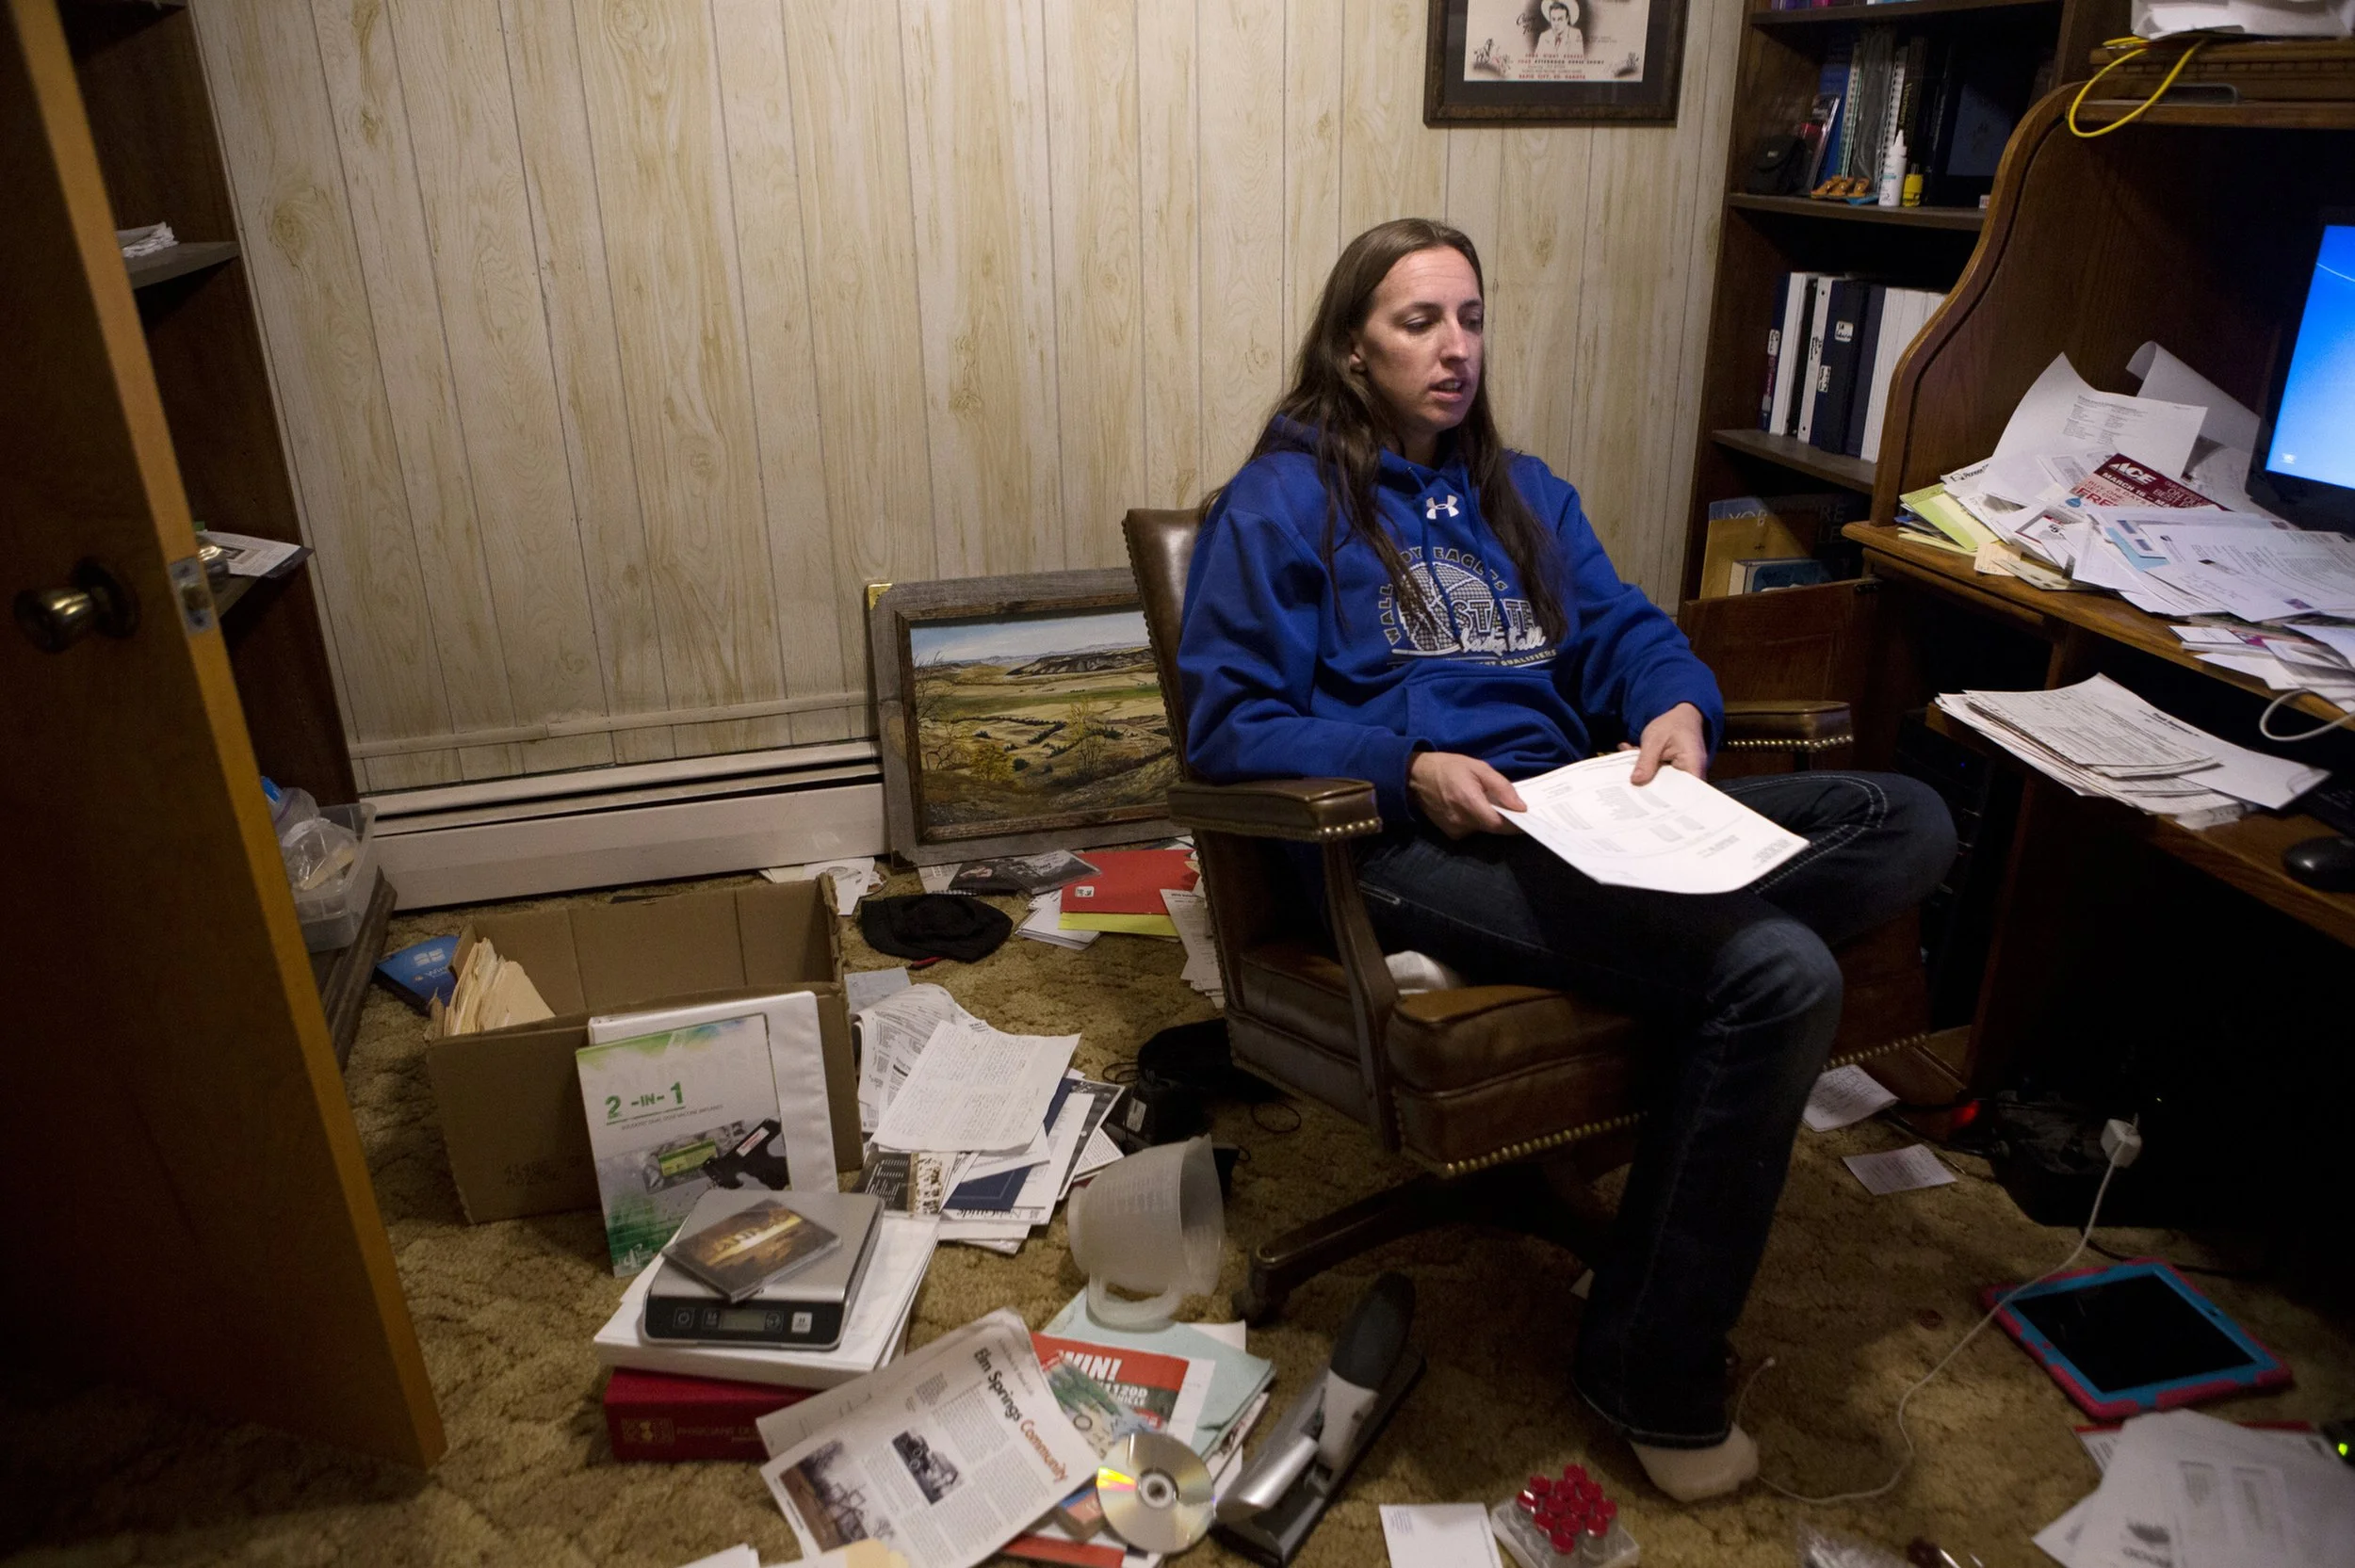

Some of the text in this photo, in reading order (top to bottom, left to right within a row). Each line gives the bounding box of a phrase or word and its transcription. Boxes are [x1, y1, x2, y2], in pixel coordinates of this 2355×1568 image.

[2101, 472, 2135, 492] MARCH
[2108, 462, 2157, 485] ACE
[1378, 583, 1402, 646] WALL
[605, 1094, 622, 1119] 2
[670, 1080, 685, 1106] 1
[974, 1347, 993, 1373] Elm
[987, 1369, 1023, 1422] Springs
[1020, 1418, 1069, 1485] Community
